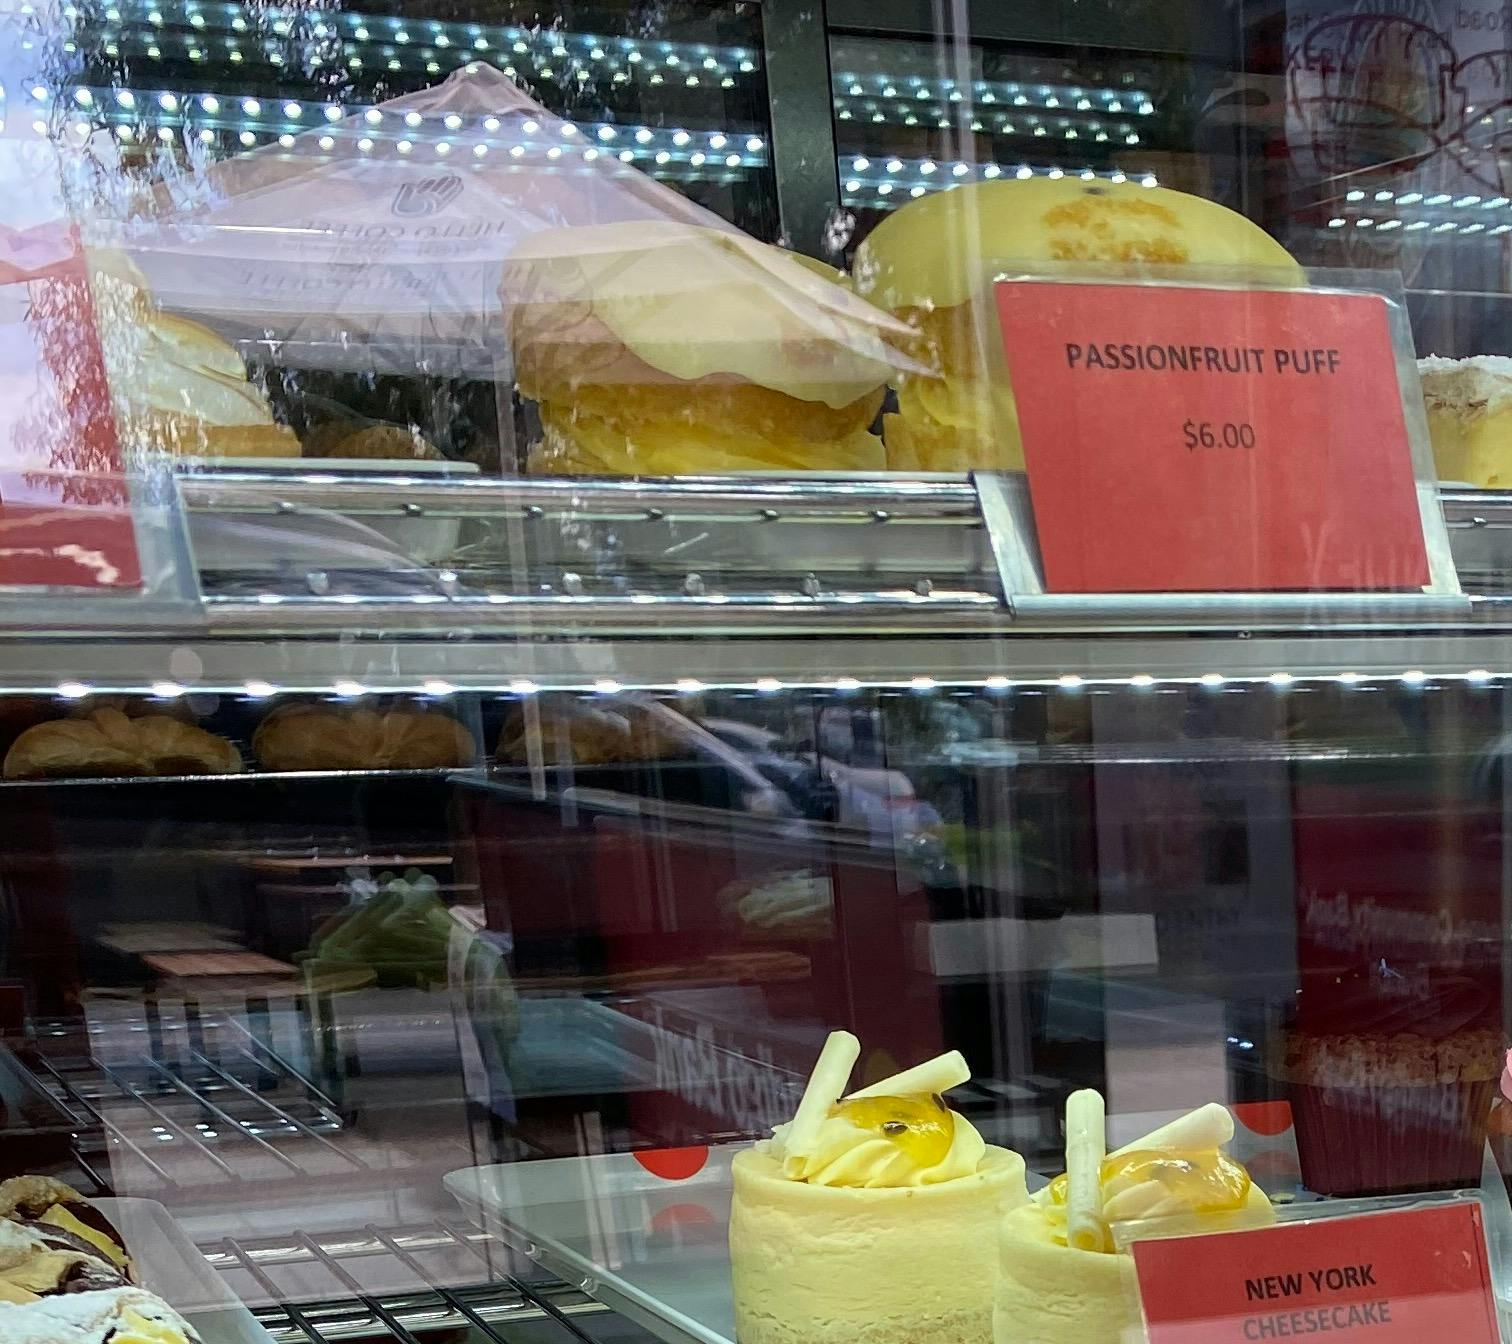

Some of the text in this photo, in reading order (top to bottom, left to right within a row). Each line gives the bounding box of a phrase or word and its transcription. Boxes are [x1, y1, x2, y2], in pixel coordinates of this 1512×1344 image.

[1065, 343, 1342, 374] PASSIONFRUIT PUFF
[1183, 418, 1256, 451] $6.00
[1245, 1264, 1377, 1301] NEW YORK
[1243, 1301, 1392, 1340] CHEESECAKE
